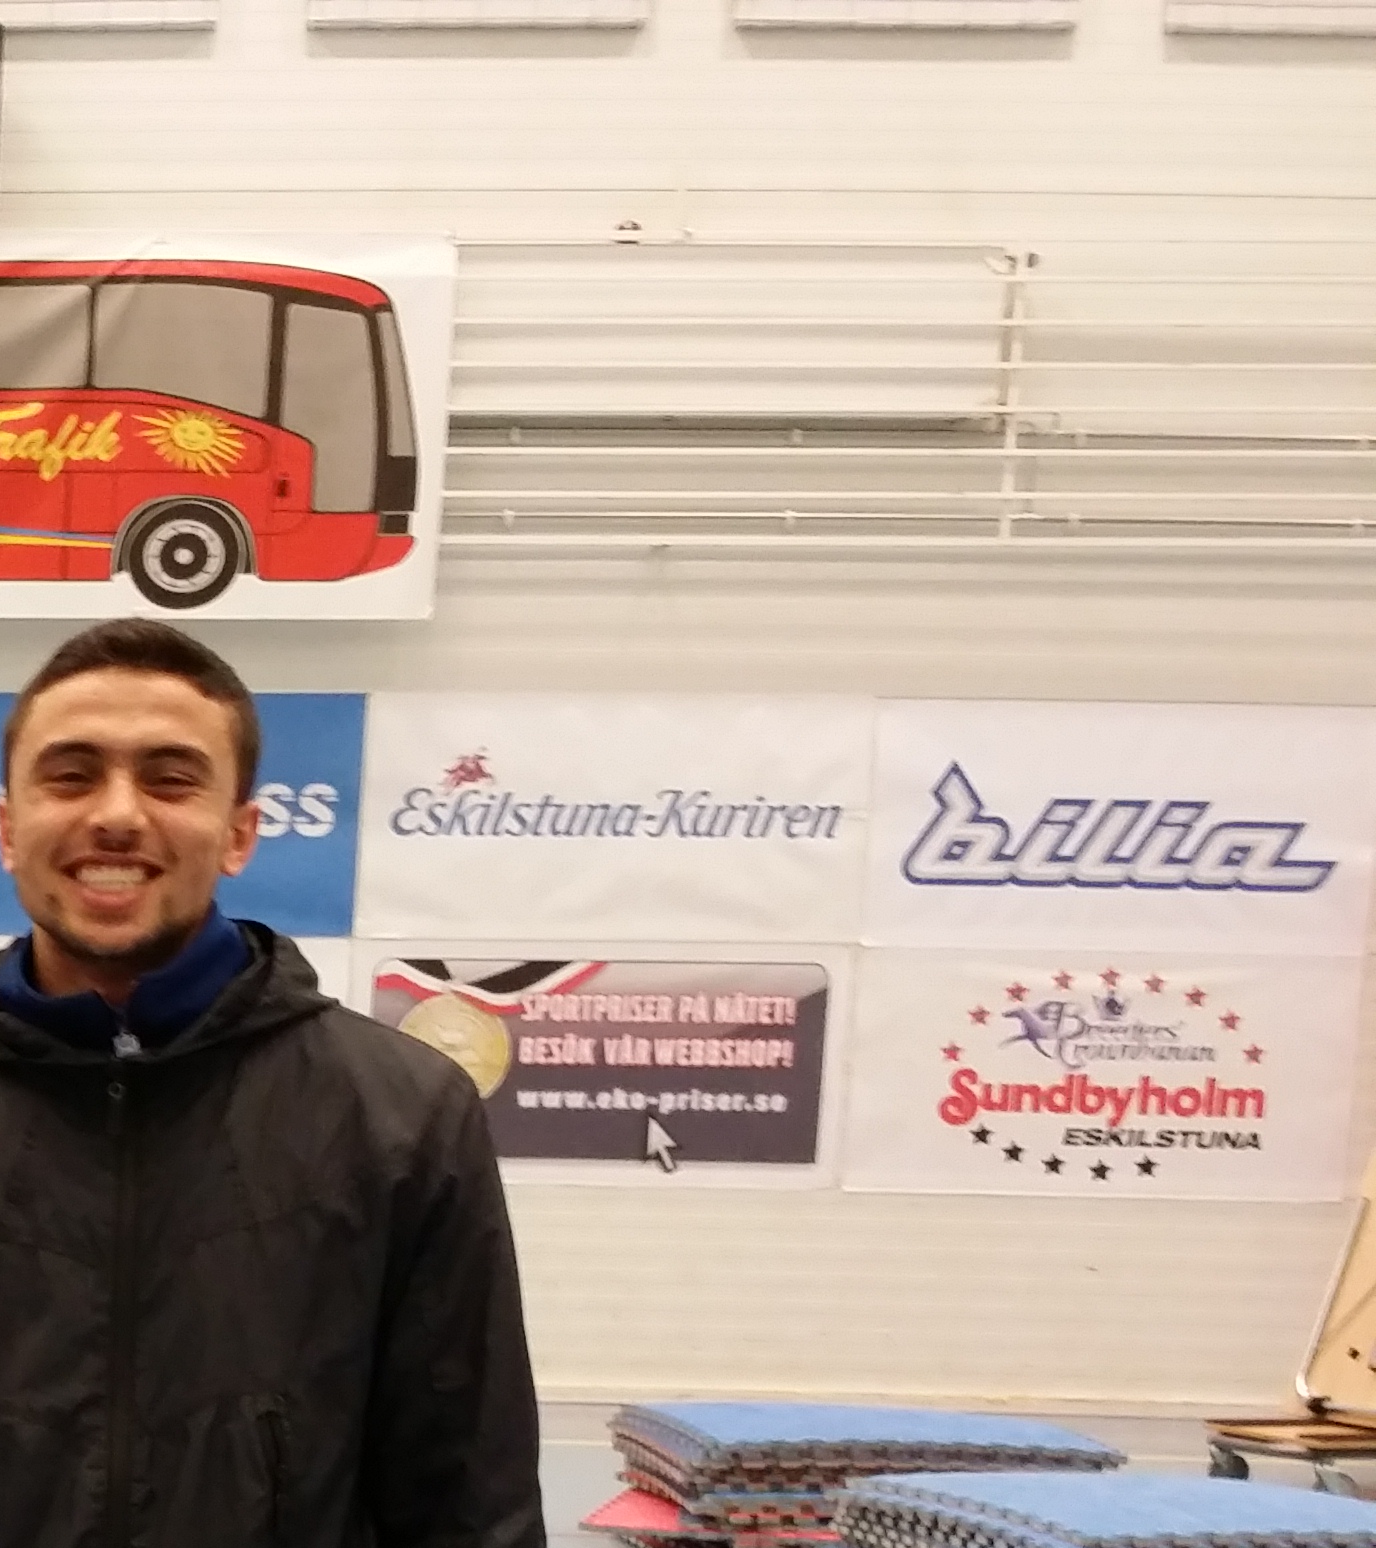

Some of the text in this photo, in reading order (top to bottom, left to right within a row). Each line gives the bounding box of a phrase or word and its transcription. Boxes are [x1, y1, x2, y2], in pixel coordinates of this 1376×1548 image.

[389, 787, 843, 838] Eskilstuna-Kuriren
[520, 994, 673, 1023] SPORTPRISER
[518, 1033, 597, 1066] BESÖK
[653, 1037, 795, 1068] WEBBSHOP!
[515, 1087, 789, 1115] www.eko-priser.se
[938, 1067, 1265, 1127] Sundbyholm
[1061, 1127, 1262, 1151] ESKILSTUNA
